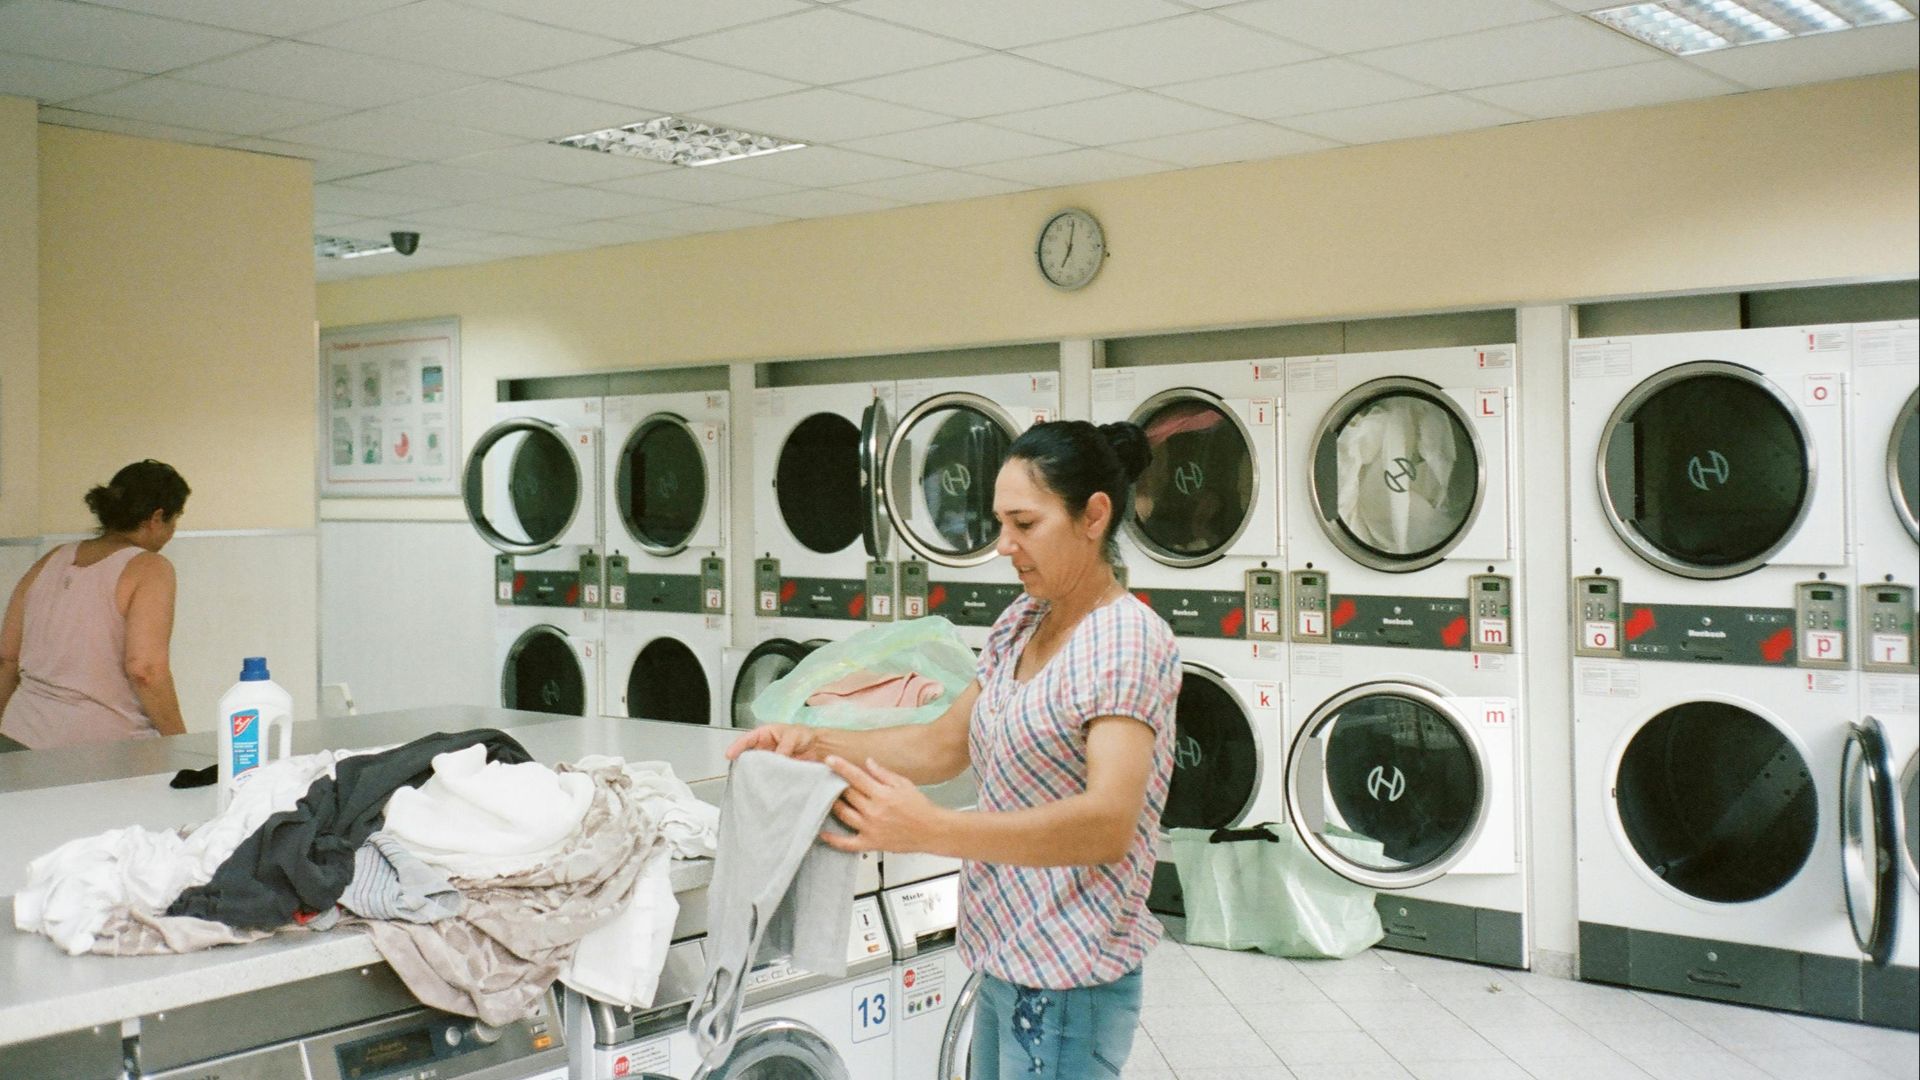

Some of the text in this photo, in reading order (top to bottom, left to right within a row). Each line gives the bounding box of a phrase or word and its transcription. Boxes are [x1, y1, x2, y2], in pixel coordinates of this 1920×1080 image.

[1482, 398, 1495, 415] L
[1258, 407, 1264, 423] i
[911, 602, 919, 616] g
[1261, 616, 1271, 631] k
[1306, 619, 1317, 633] L
[1485, 629, 1502, 642] m
[1594, 633, 1606, 646] o
[1817, 638, 1831, 656] p
[1886, 646, 1897, 661] r
[1260, 690, 1271, 706] k
[1486, 710, 1505, 723] m
[857, 993, 887, 1028] 13
